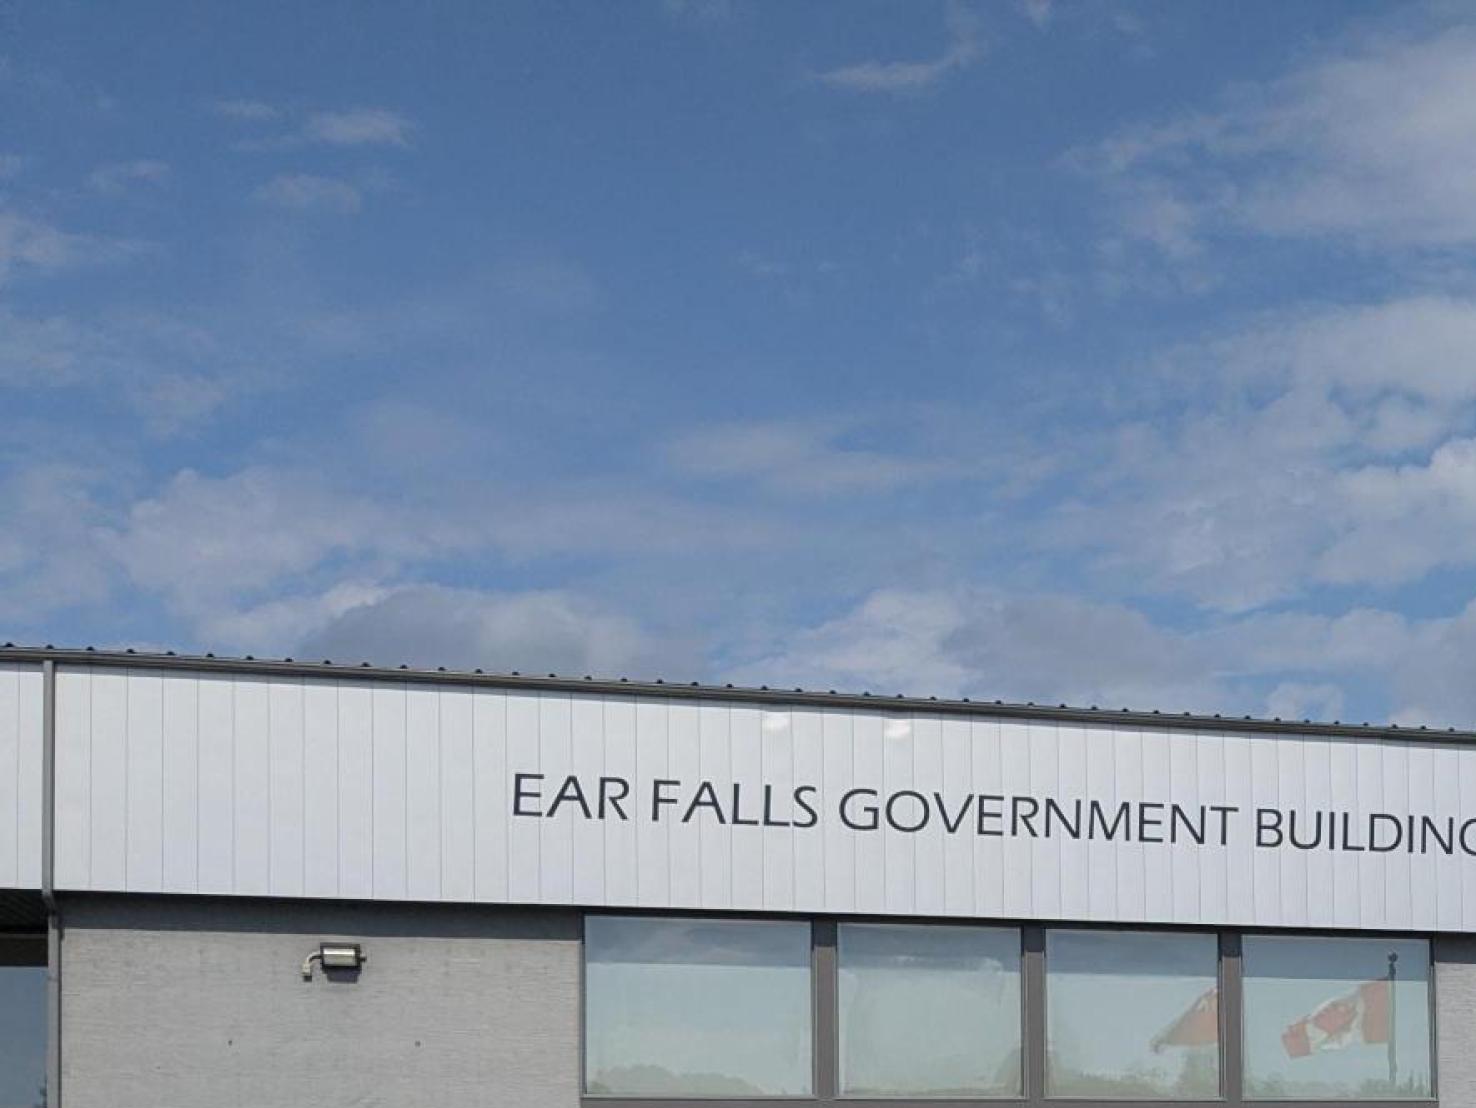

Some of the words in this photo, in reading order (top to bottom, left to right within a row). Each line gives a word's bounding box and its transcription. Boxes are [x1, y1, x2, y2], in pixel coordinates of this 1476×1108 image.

[514, 774, 629, 820] EAR
[652, 780, 817, 827] FALLS
[838, 788, 1239, 846] GOVERNMENT
